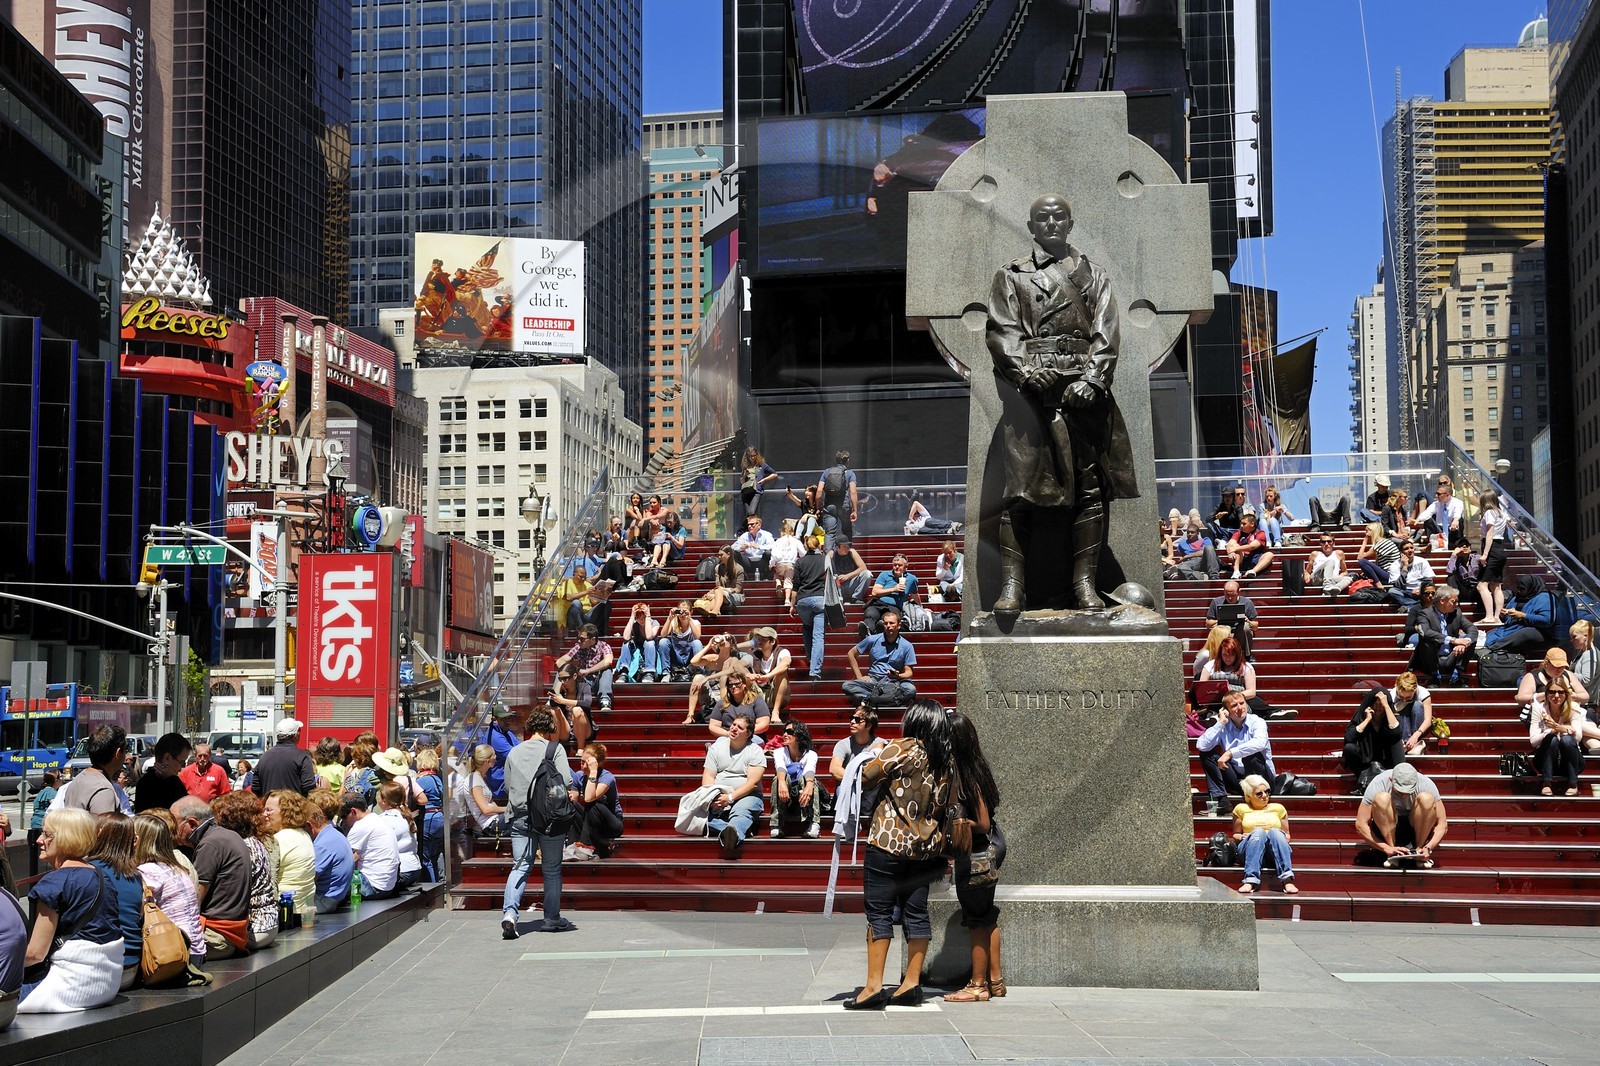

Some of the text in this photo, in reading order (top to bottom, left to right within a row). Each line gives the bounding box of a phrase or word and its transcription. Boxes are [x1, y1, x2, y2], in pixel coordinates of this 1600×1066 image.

[132, 27, 144, 189] Milk Chocolate
[541, 246, 558, 263] By
[521, 260, 577, 280] George,
[539, 280, 559, 291] we
[529, 292, 568, 308] did it.
[121, 296, 232, 340] Reese's
[525, 318, 571, 330] LEADERSHIP
[546, 330, 552, 338] It
[312, 330, 321, 410] HERSHEYS
[162, 549, 212, 560] W 47 St
[320, 564, 377, 682] tkts
[985, 689, 1159, 710] FATHER DUFFY
[10, 755, 25, 763] Hop
